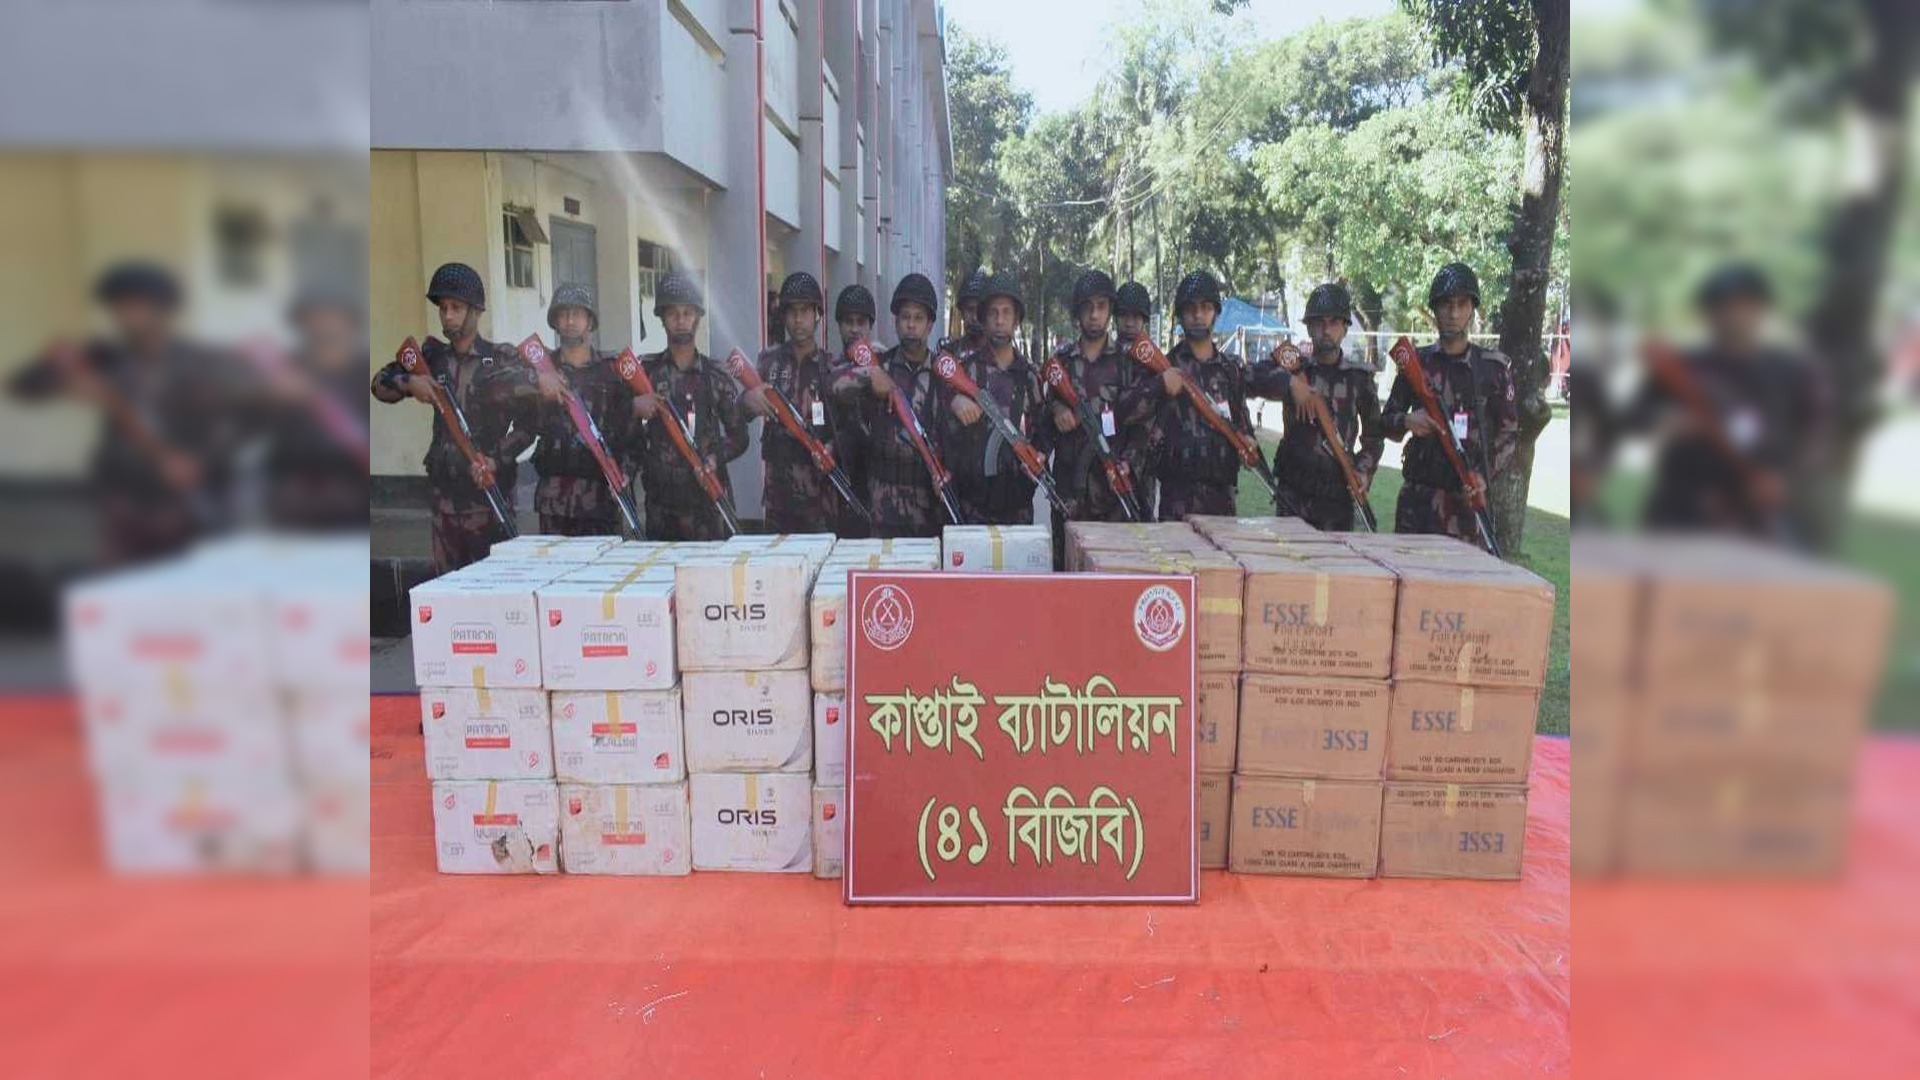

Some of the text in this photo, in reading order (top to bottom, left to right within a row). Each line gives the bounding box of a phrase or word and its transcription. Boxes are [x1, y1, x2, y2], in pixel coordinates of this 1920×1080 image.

[704, 603, 766, 621] ORIS
[1263, 602, 1310, 625] ESSE
[1420, 609, 1466, 632] ESSE
[713, 709, 773, 726] ORIS
[864, 674, 1183, 761] কাপ্তাই ব্যাটালিয়ন
[1411, 710, 1456, 731] ESSE
[1323, 730, 1368, 750] ESSE
[718, 809, 777, 825] ORIS
[1251, 807, 1299, 829] ESSE
[918, 786, 1144, 881] (৪১ বিজিবি)
[1459, 831, 1506, 852] ESSE
